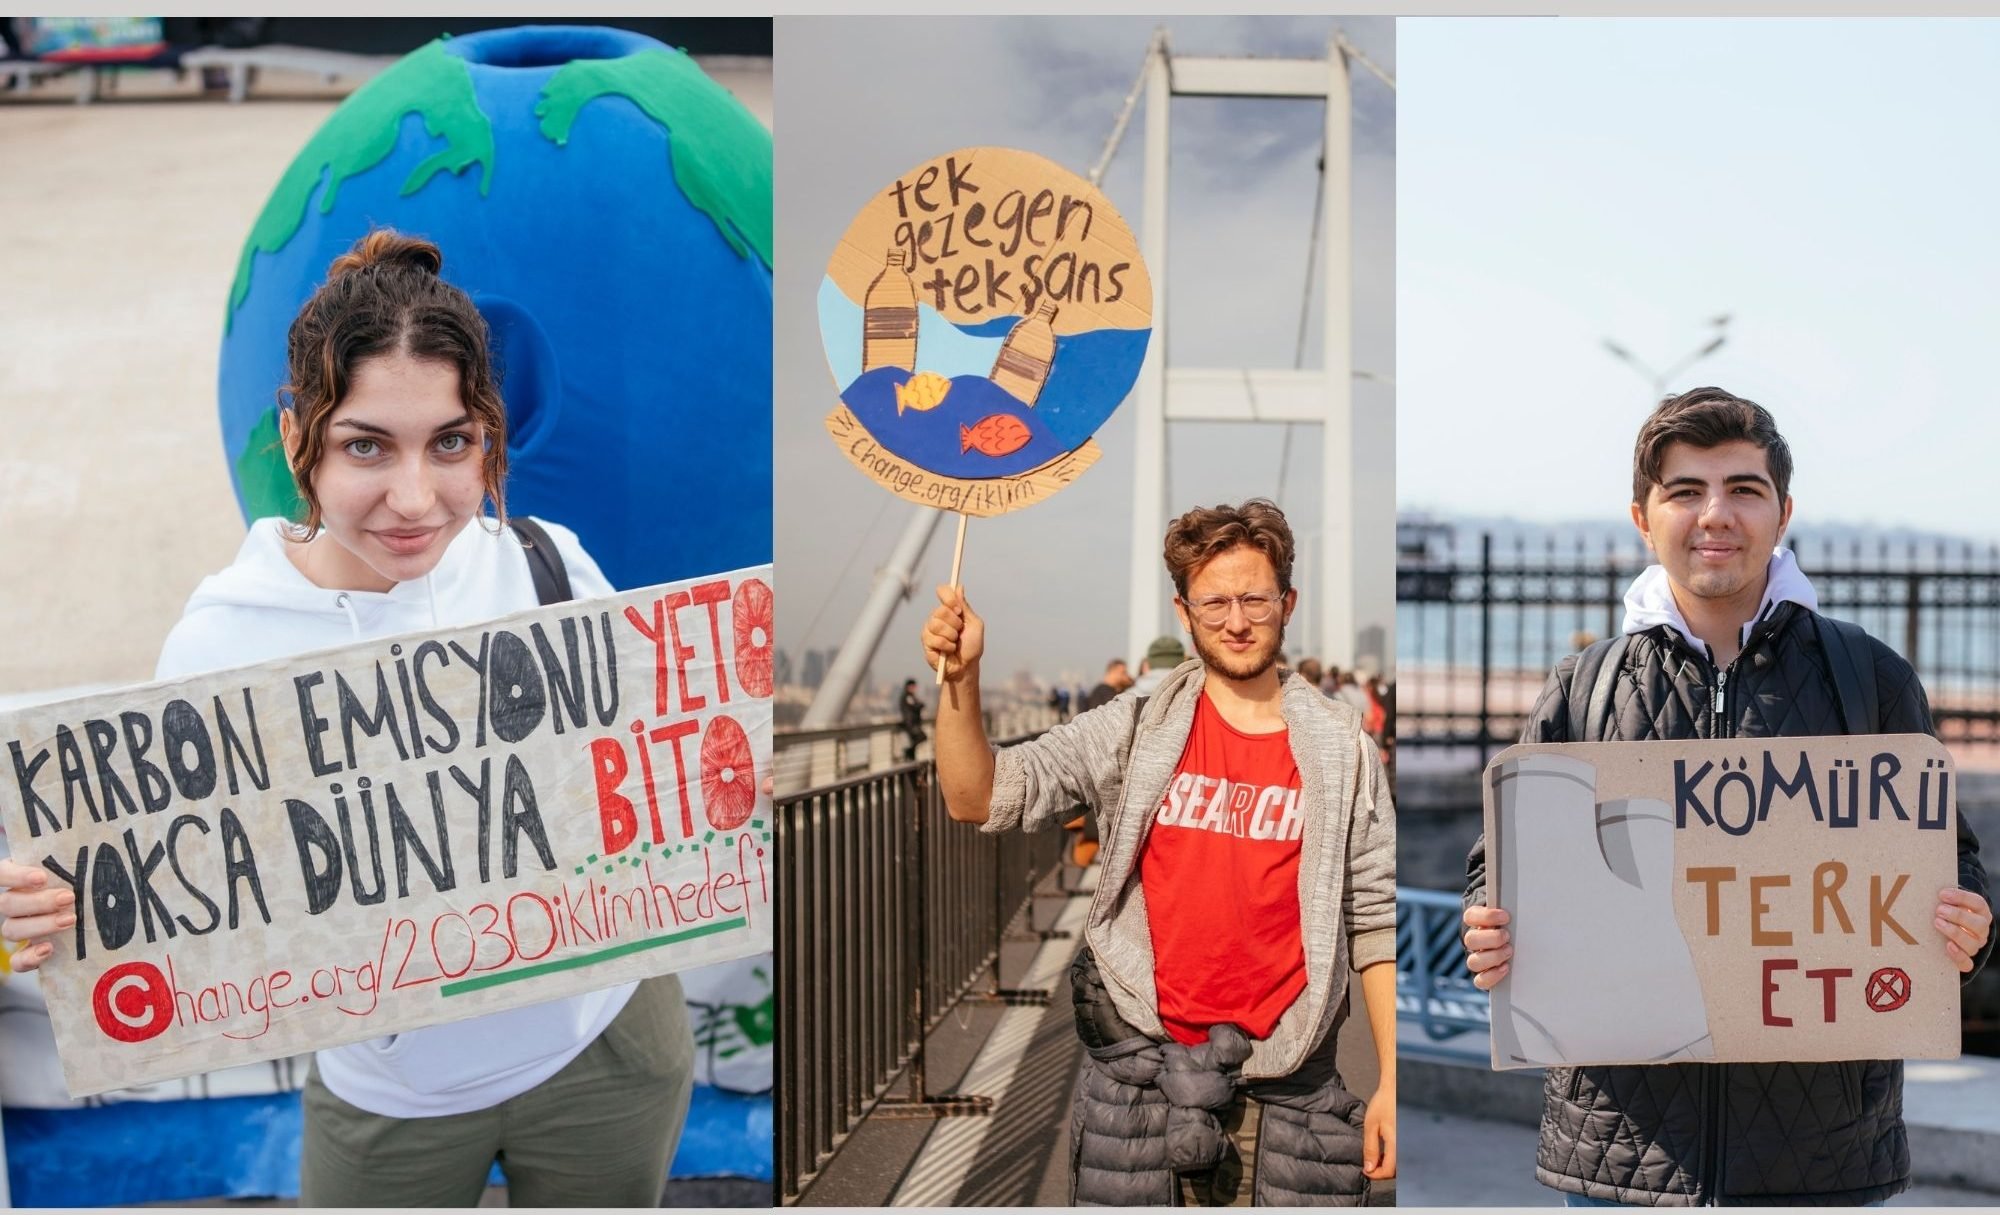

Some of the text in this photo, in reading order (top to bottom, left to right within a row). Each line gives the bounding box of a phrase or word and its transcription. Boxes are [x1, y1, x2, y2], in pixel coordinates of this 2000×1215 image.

[849, 436, 1035, 511] change.org/iklim
[7, 579, 773, 838] KARBON EMİSYONU YETO
[1674, 750, 1949, 836] KÖMÜRÜ
[42, 714, 756, 961] YOKSA DÜNYA BİTO
[1686, 861, 1920, 947] TERK
